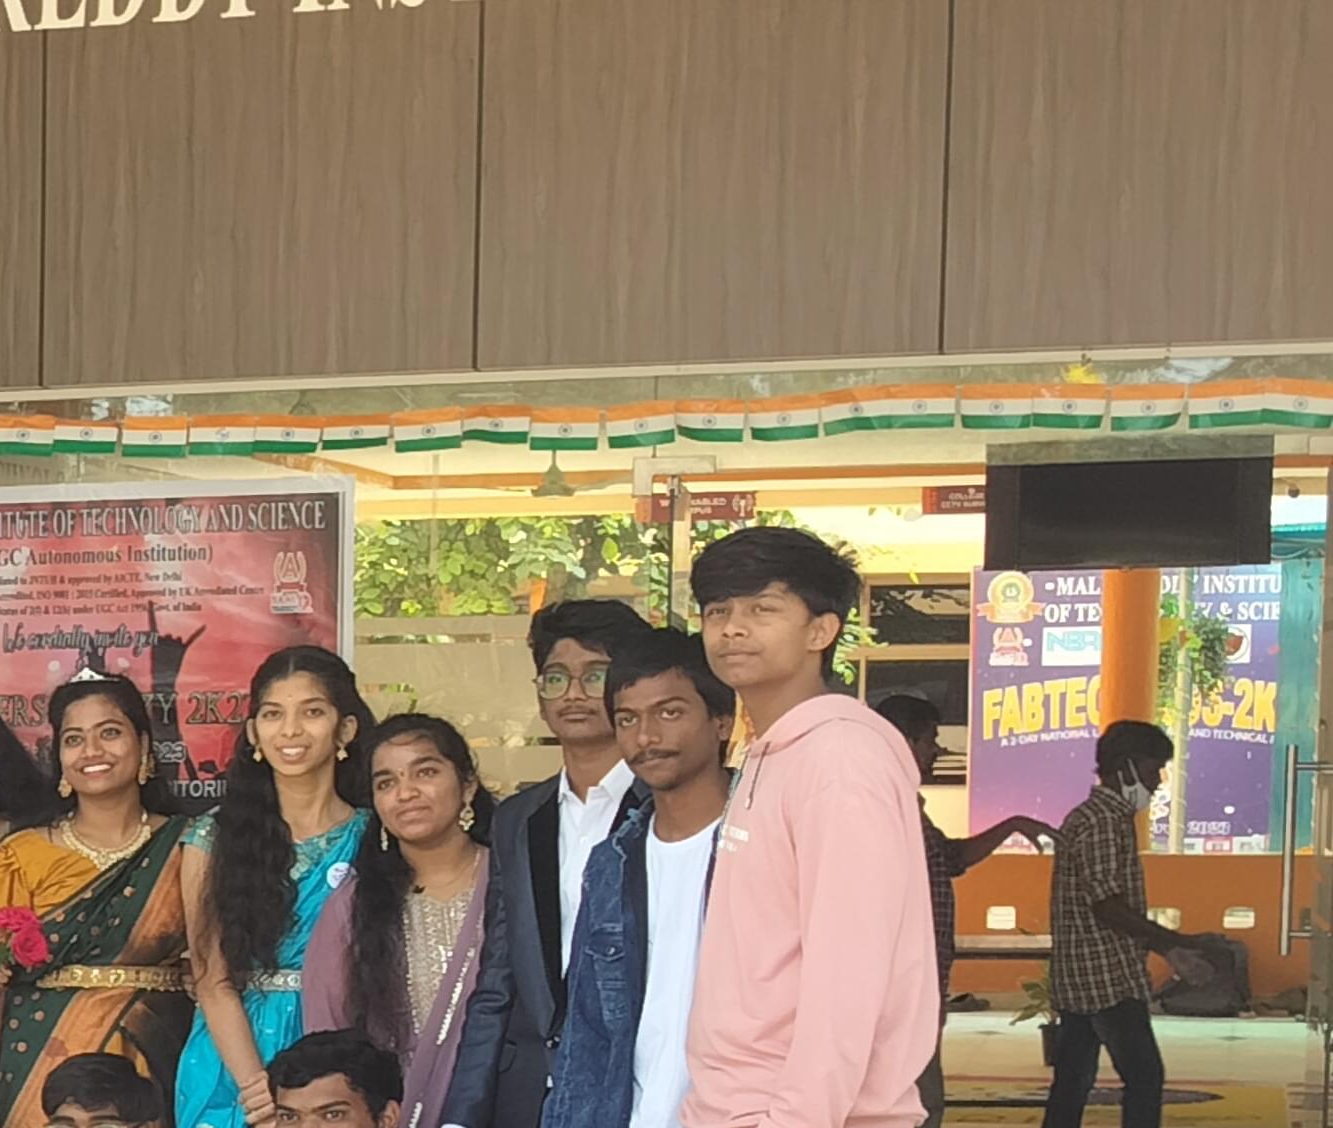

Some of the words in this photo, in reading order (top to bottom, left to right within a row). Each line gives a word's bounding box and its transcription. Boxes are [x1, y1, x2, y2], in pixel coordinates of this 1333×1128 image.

[53, 509, 76, 538] OF
[80, 504, 203, 536] TECHNOLOGY
[205, 504, 244, 532] AND
[247, 501, 326, 531] SCIENCE
[26, 547, 122, 566] Autonomous
[128, 542, 213, 564] Institution)
[1056, 576, 1102, 596] MAL
[1202, 574, 1282, 594] INSTITU
[1044, 603, 1071, 622] OF
[1236, 601, 1281, 621] SCIE
